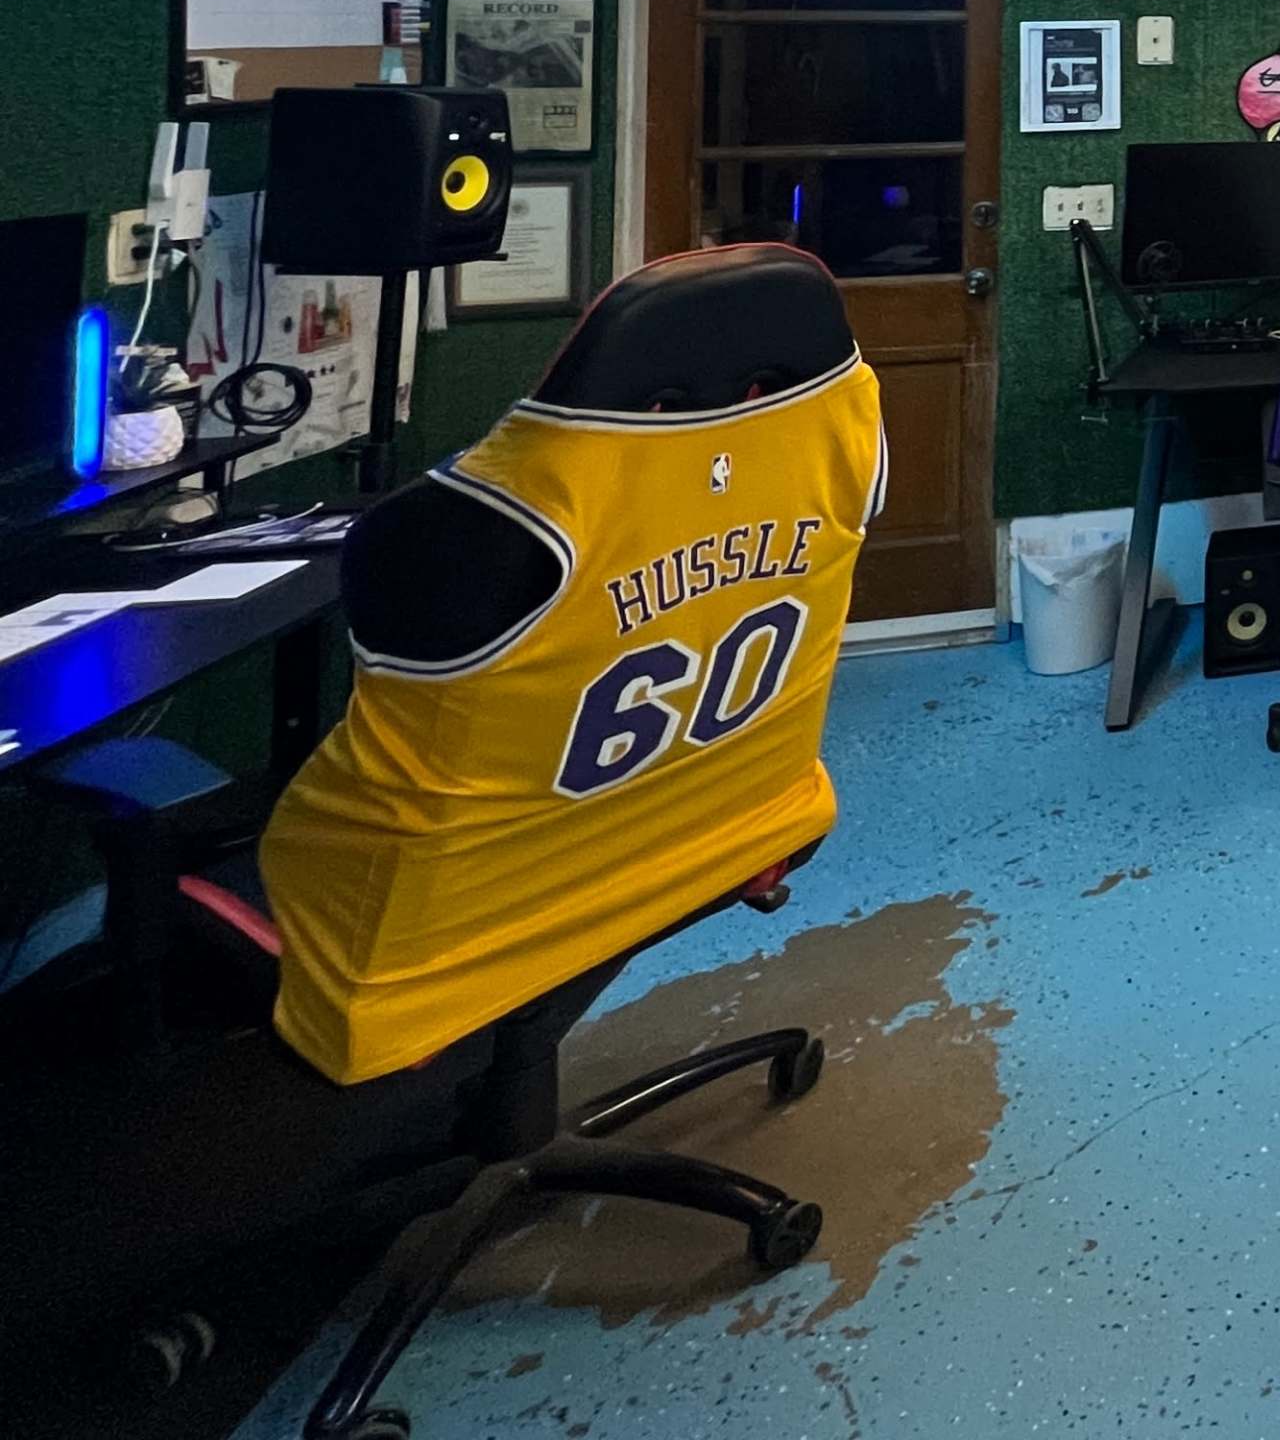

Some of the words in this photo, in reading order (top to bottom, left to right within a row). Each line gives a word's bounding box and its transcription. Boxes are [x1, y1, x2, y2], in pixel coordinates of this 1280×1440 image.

[483, 3, 560, 15] RECORD
[605, 517, 823, 638] HUSSLE
[553, 594, 808, 800] 60
